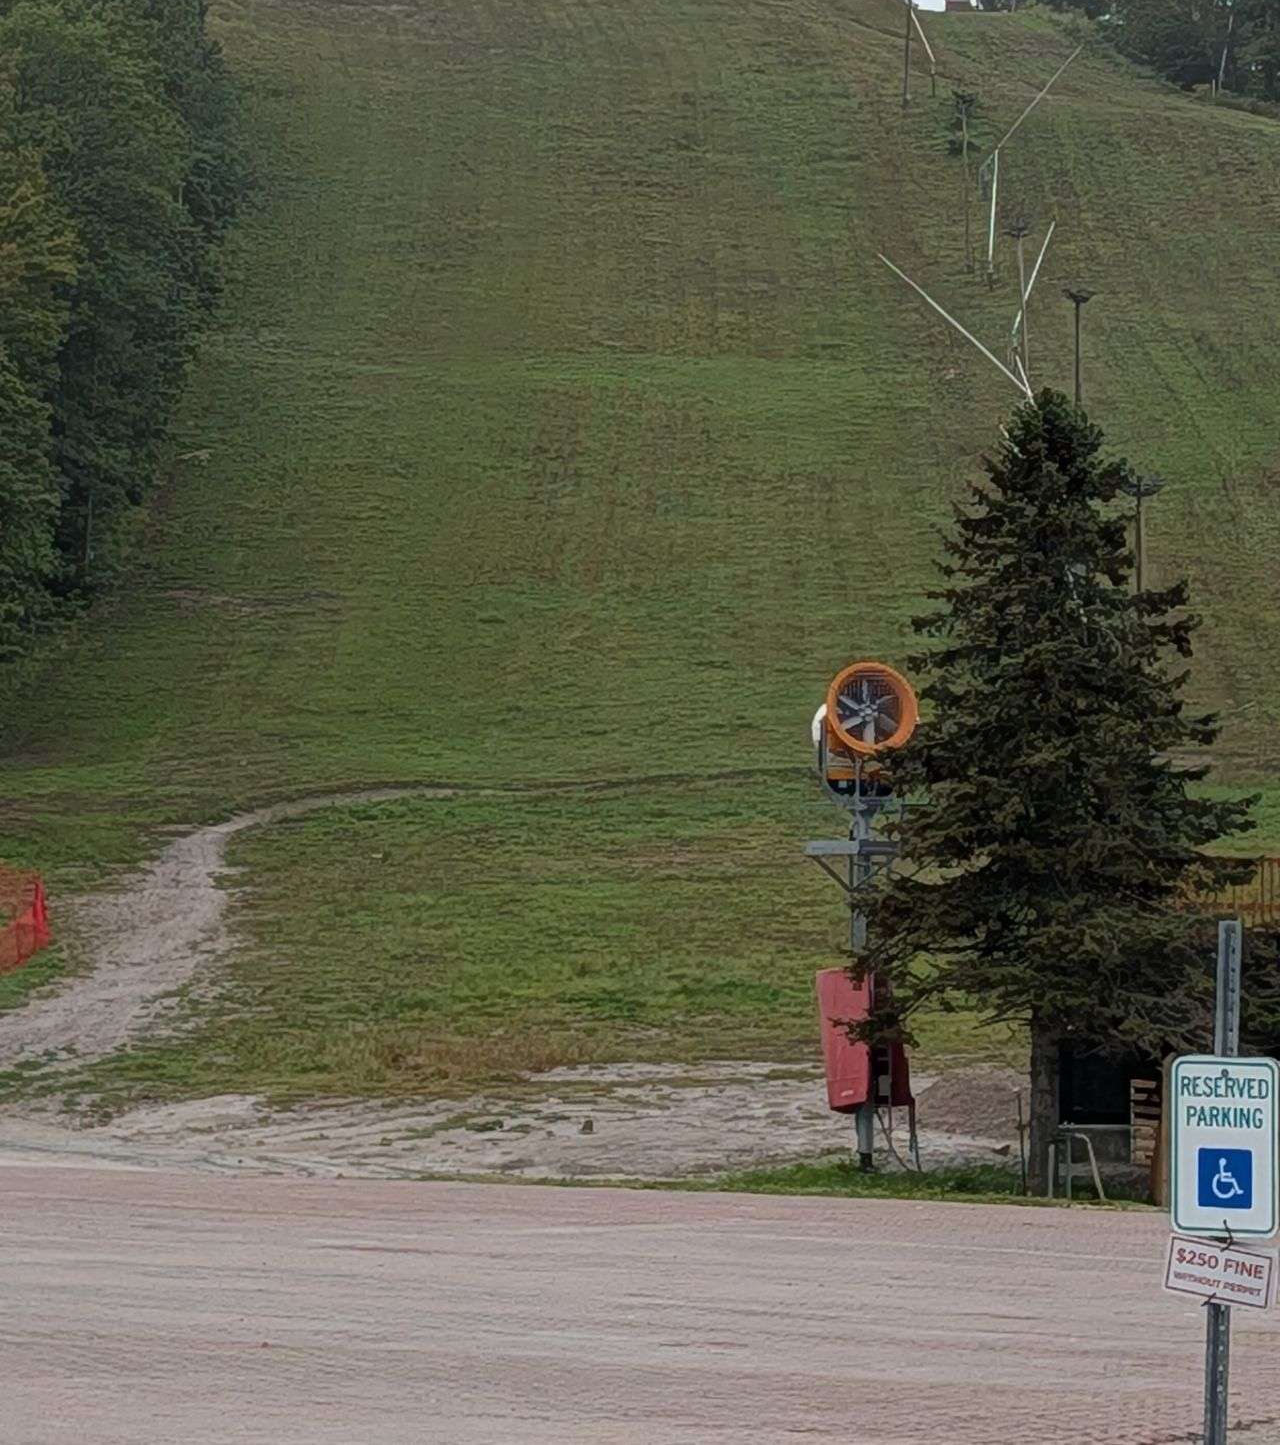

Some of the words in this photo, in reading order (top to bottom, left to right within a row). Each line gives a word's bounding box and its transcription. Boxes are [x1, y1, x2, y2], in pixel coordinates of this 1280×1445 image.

[1181, 1075, 1269, 1099] RESERVED
[1186, 1105, 1263, 1129] PARKING
[1176, 1248, 1219, 1270] $250
[1223, 1257, 1265, 1279] FINE
[1173, 1271, 1221, 1288] WITHOUT
